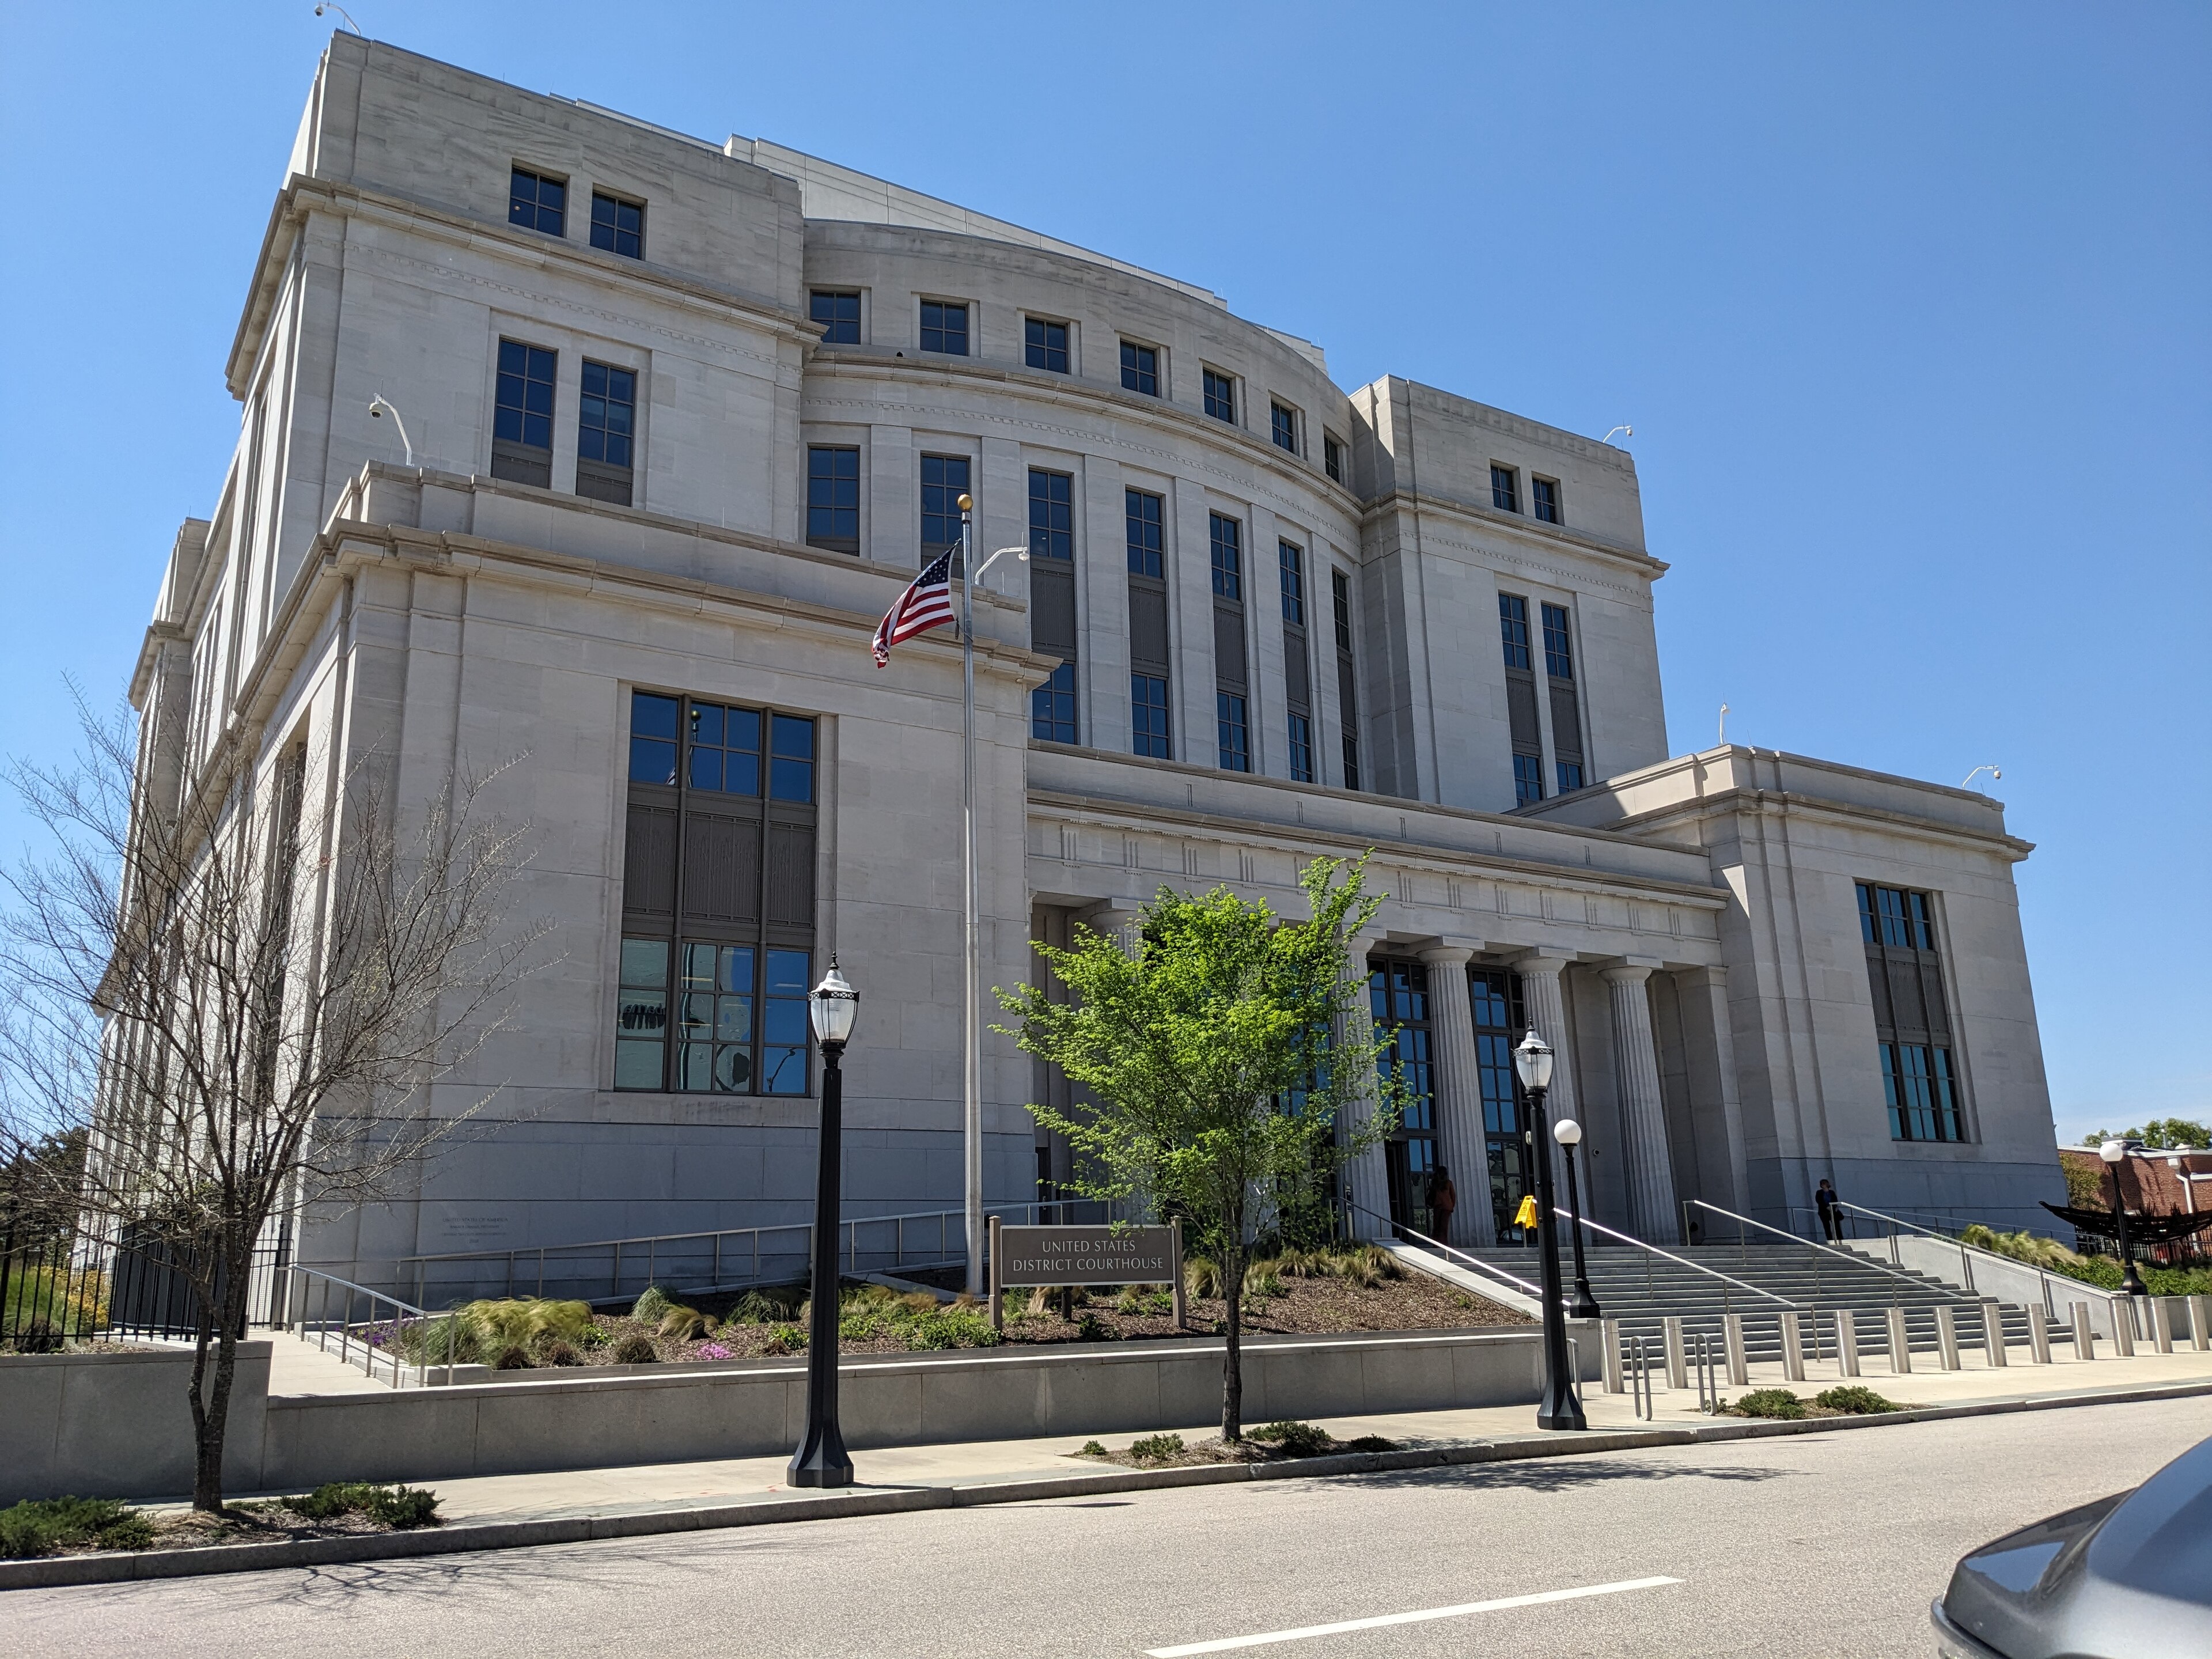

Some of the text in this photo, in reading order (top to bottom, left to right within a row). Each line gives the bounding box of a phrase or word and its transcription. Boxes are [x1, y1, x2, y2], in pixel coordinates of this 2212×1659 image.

[1043, 1240, 1135, 1252] UNITED STATES
[1013, 1257, 1163, 1271] DISTRICT COURTHOUSE
